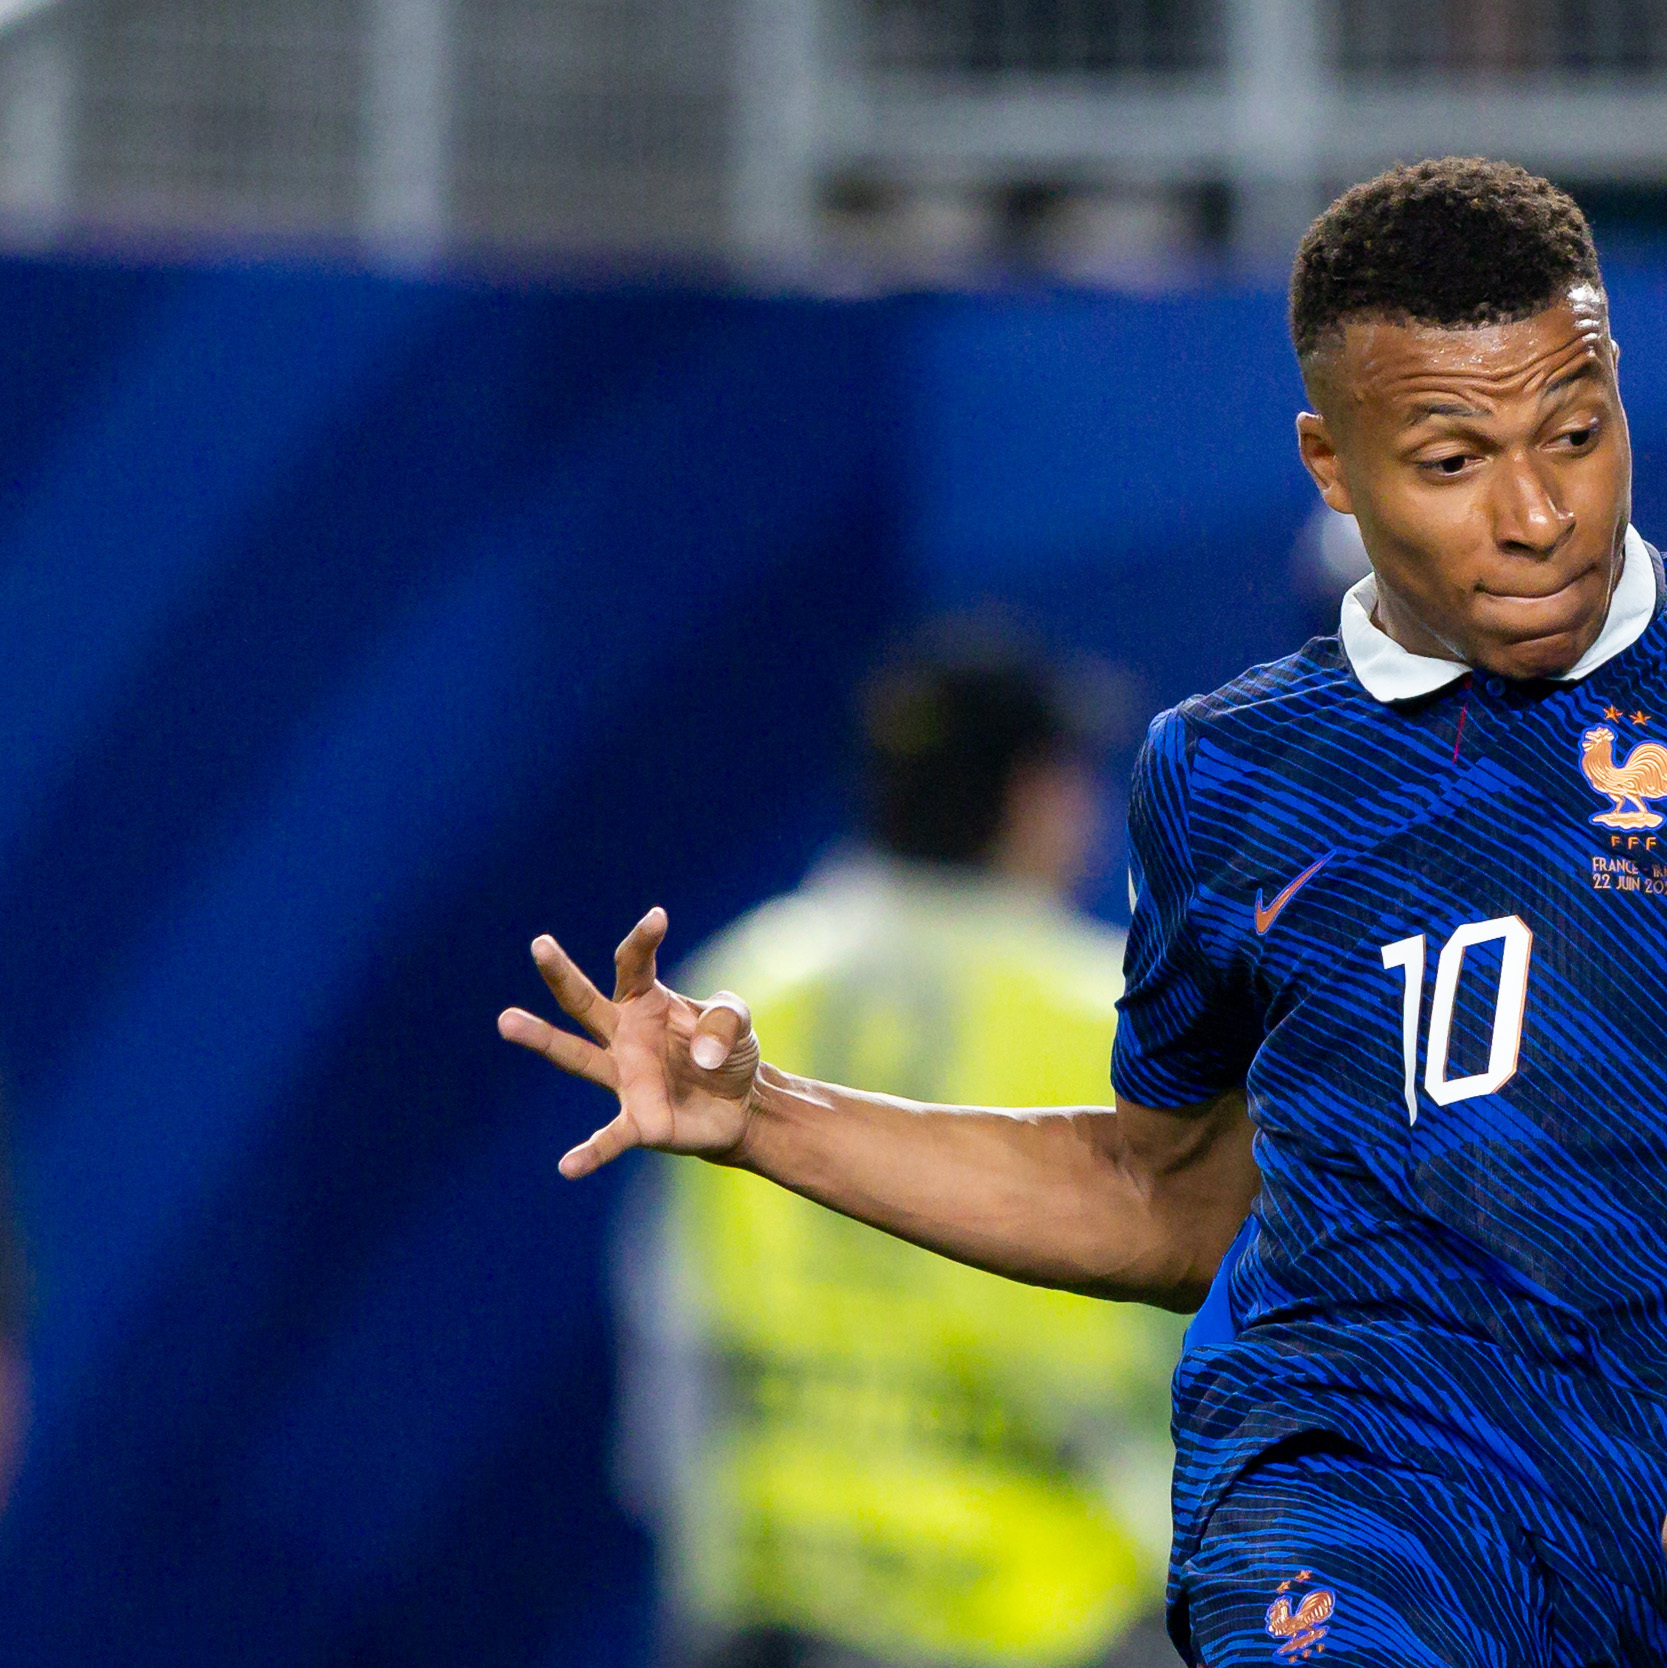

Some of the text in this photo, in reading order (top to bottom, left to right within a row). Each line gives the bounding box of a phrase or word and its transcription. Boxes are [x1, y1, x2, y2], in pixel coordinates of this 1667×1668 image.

[1592, 856, 1639, 875] FRANCE
[1592, 873, 1611, 889] 22
[1616, 875, 1640, 891] JUIN
[1380, 914, 1533, 1127] 10
